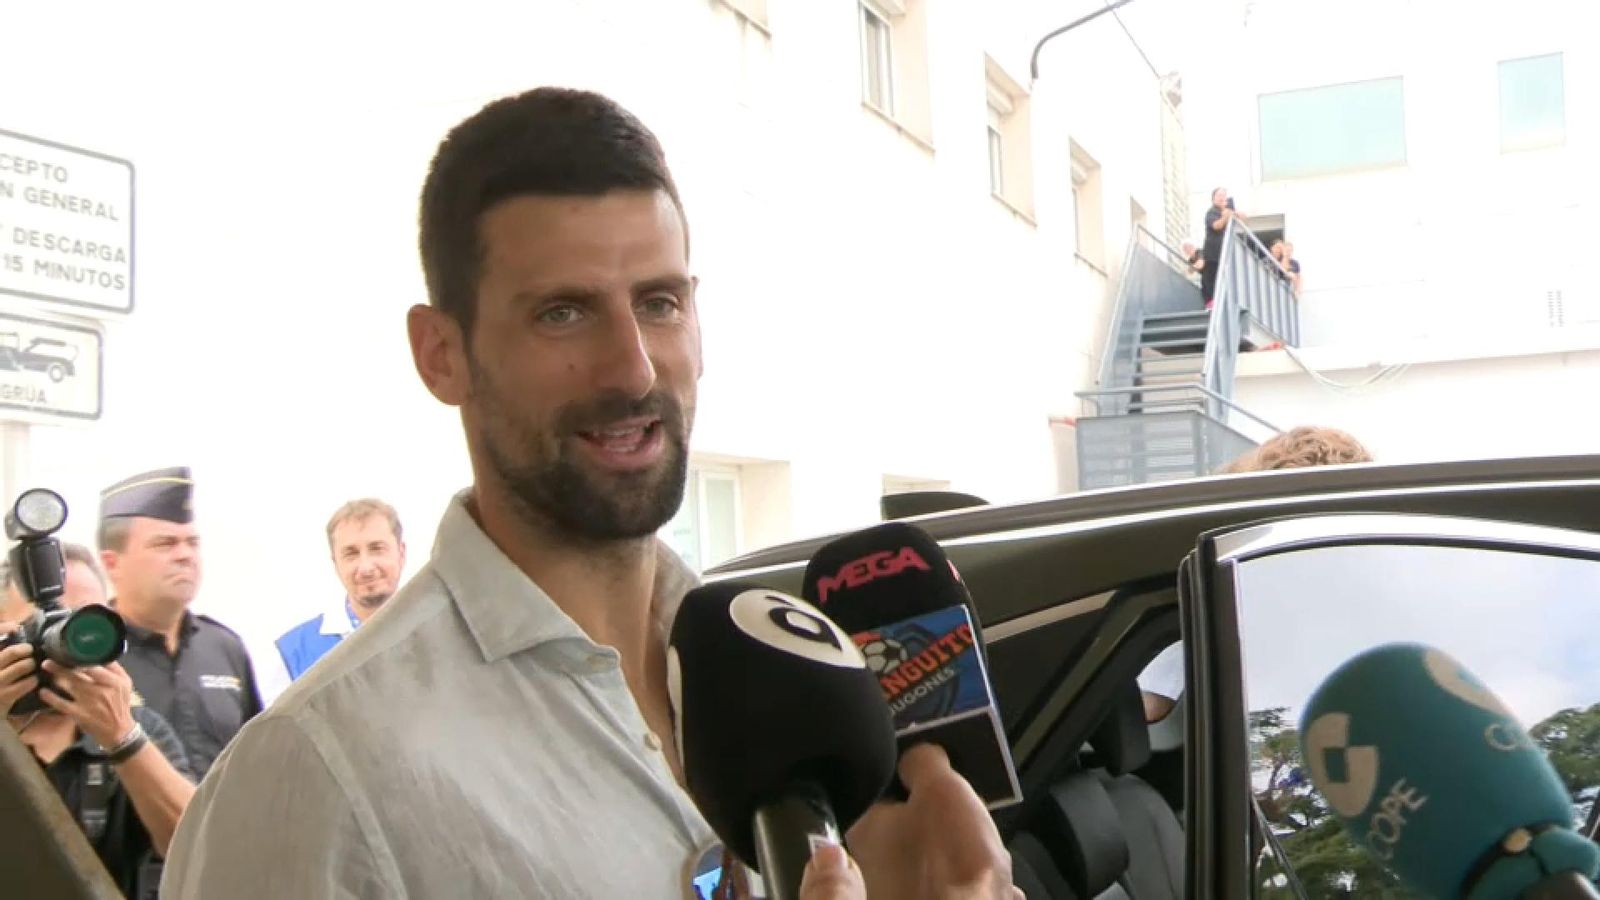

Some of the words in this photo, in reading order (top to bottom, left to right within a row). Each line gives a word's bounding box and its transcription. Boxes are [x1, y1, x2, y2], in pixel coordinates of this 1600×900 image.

[23, 186, 120, 222] GENERAL
[13, 226, 126, 263] DESCARGA
[4, 253, 23, 272] 15
[34, 259, 126, 291] MINUTOS
[817, 546, 931, 604] MEGA
[880, 623, 972, 704] NGUITO
[1366, 777, 1431, 862] COPE
